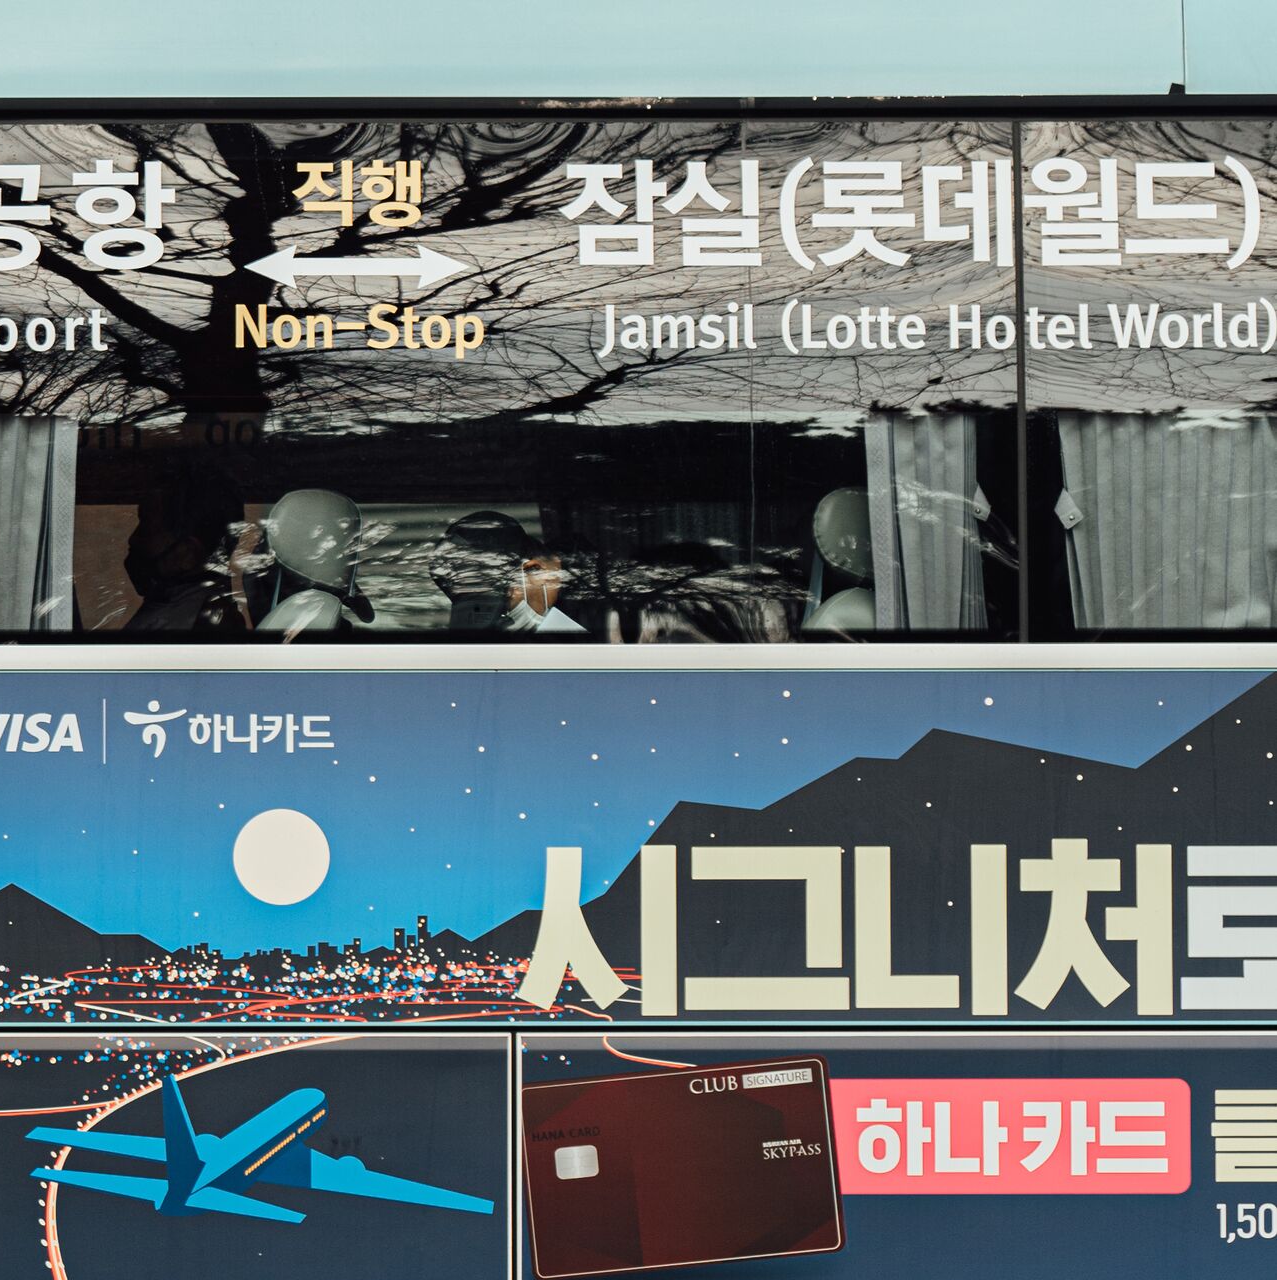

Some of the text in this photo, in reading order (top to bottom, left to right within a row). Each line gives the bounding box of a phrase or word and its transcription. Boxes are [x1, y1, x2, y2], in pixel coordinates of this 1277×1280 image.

[292, 160, 422, 227] 직행
[560, 155, 1261, 272] 잠실(롯데월드)
[234, 303, 485, 359] Non-Stop
[598, 296, 1277, 358] Jamsil (Lotte Hotel World)
[189, 713, 334, 753] 하나카드
[689, 1070, 809, 1095] CLUB SIGNATURE
[531, 1126, 601, 1142] HANA CARD
[763, 1143, 822, 1160] SKYPASS
[856, 1098, 1169, 1177] 하나카드
